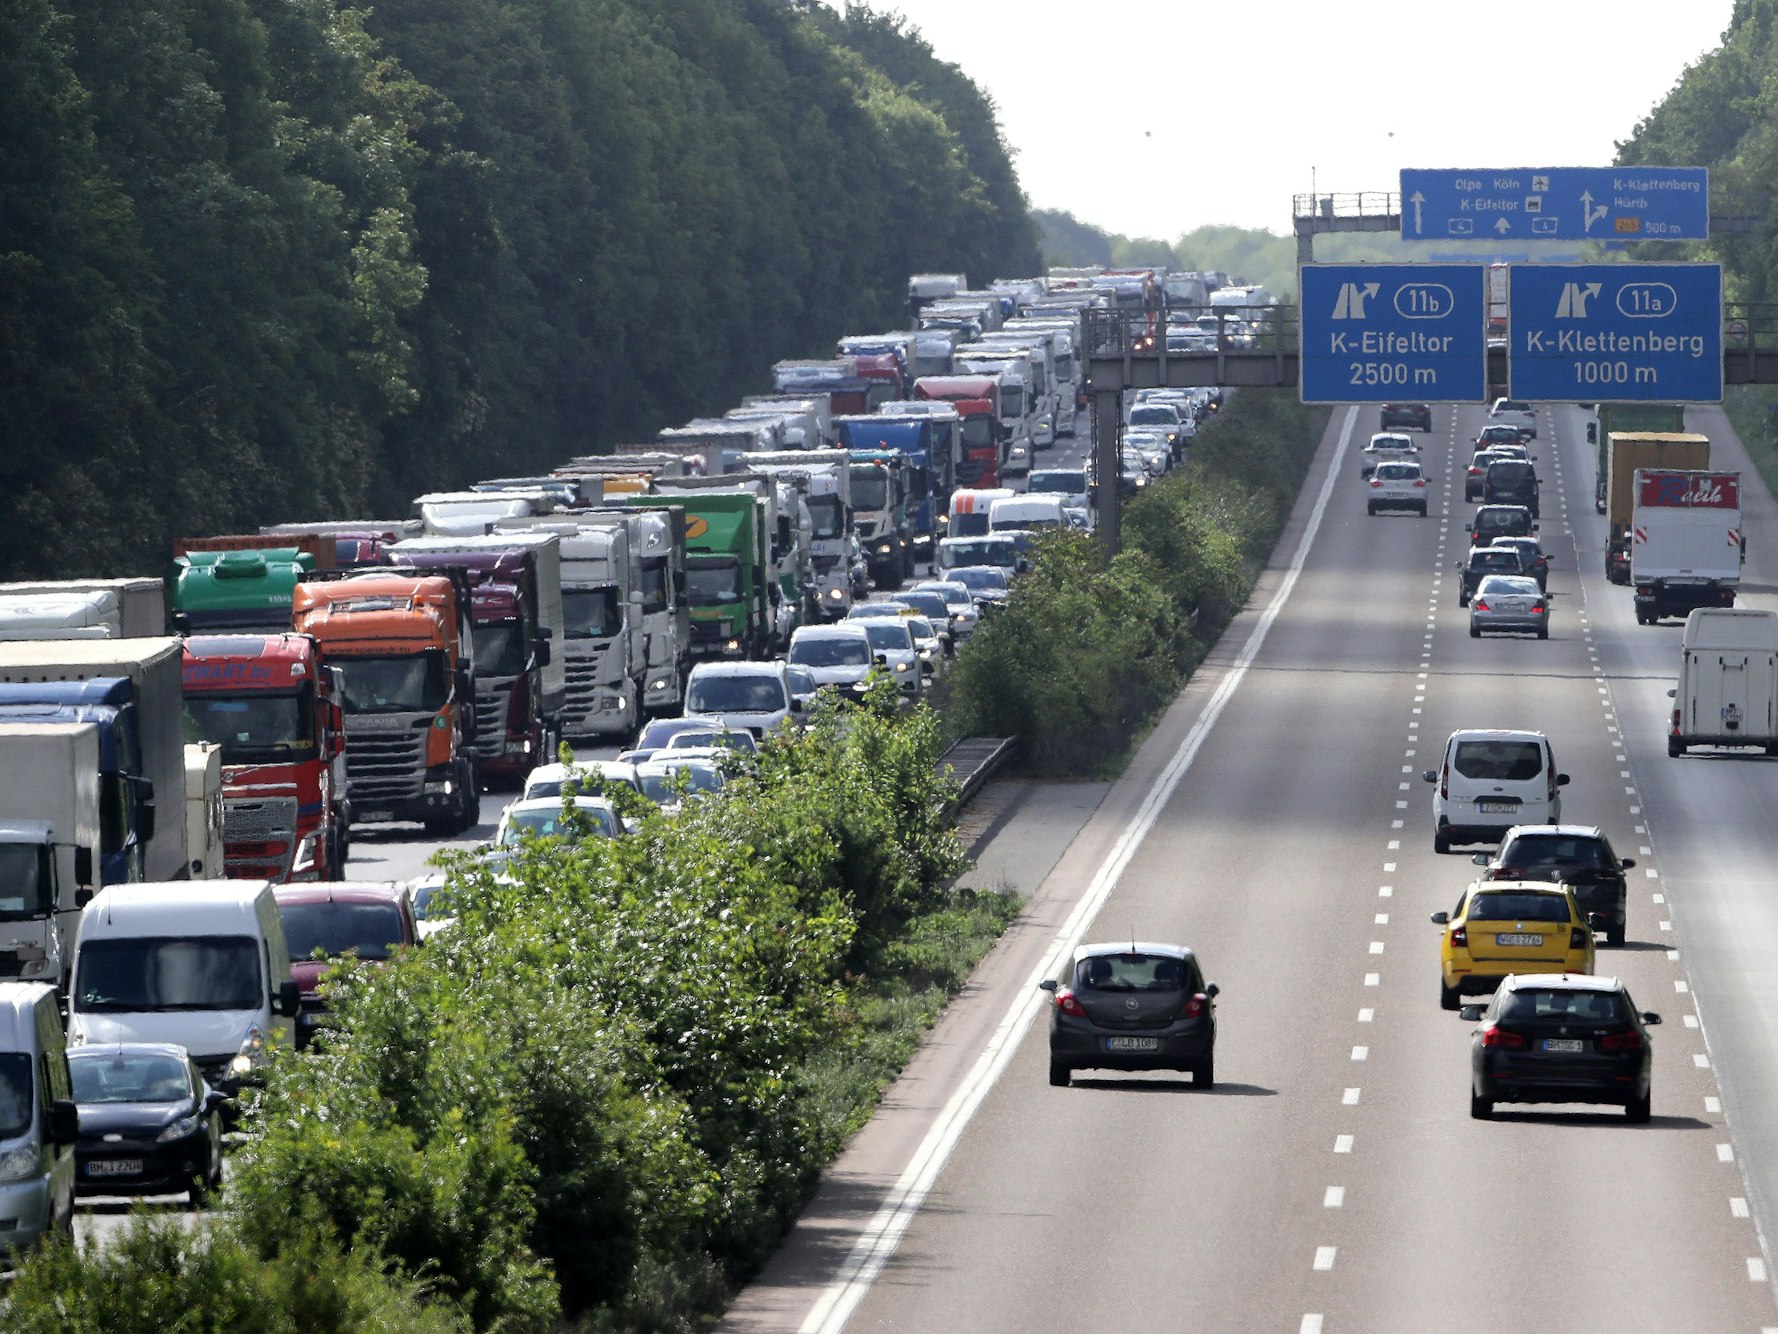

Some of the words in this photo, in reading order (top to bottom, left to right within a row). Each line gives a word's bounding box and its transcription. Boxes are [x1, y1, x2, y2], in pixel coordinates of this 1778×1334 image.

[1494, 178, 1520, 190] Köln
[1614, 179, 1700, 193] K-Klettenberg
[1409, 289, 1439, 313] 11b
[1631, 289, 1662, 312] 11a
[1331, 331, 1454, 354] K-Eifeltor
[1526, 330, 1705, 358] K-Klettenberg
[1350, 363, 1408, 385] 2500
[1414, 367, 1437, 385] m
[1574, 361, 1628, 384] 1000
[1635, 366, 1658, 384] m
